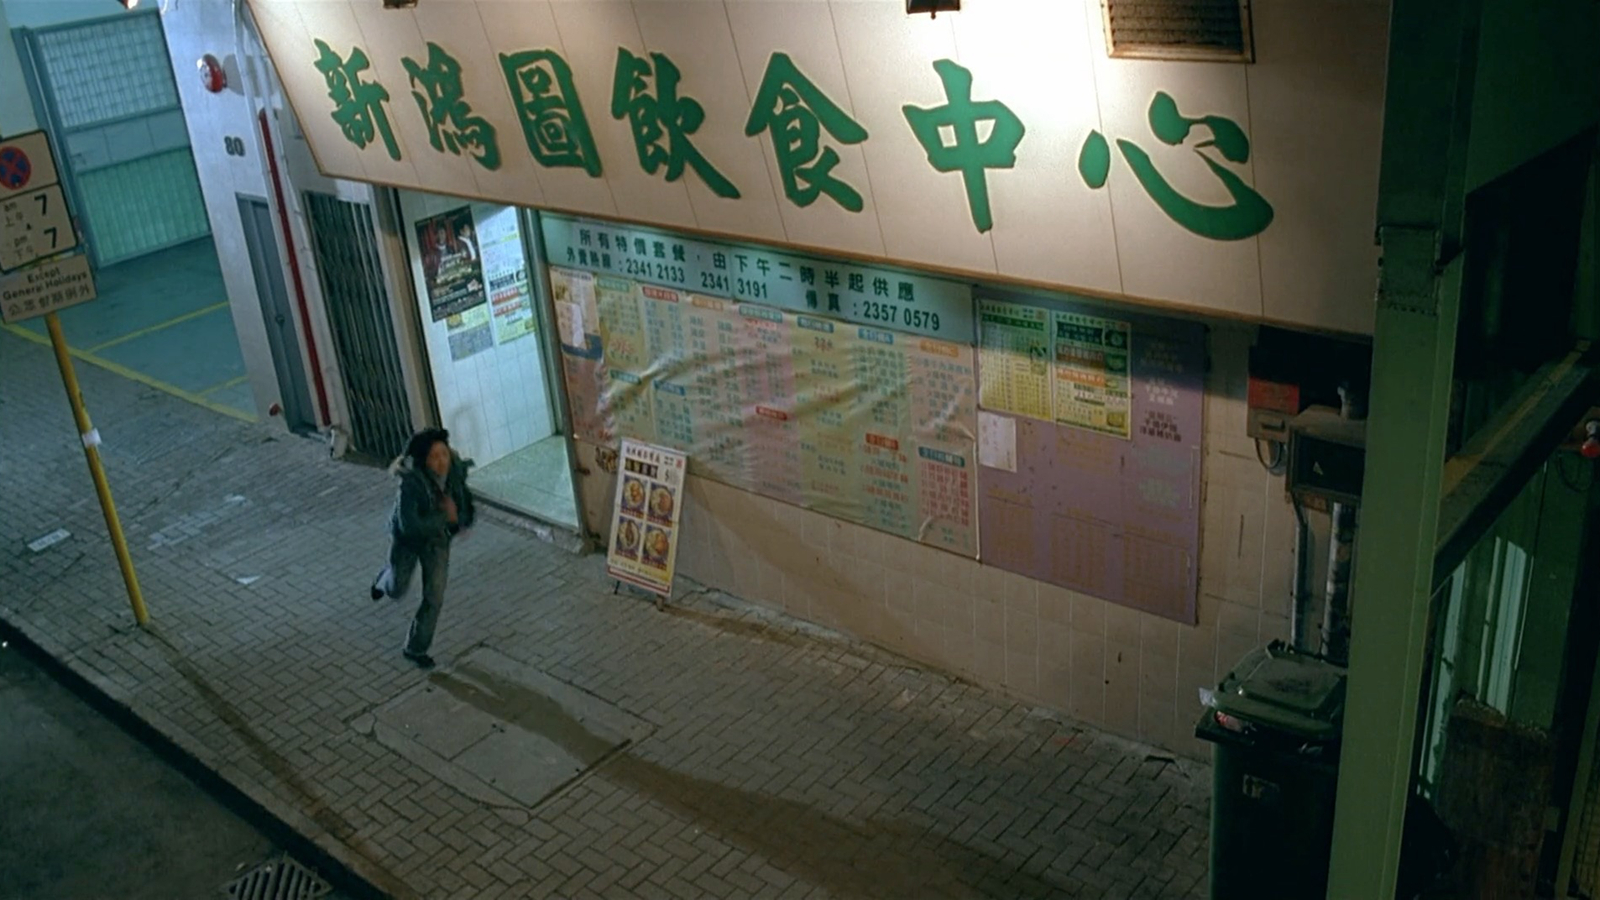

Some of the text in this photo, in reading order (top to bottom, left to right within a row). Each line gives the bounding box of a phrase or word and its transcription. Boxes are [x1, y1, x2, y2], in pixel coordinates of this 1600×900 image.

[224, 136, 245, 157] 80
[314, 38, 1274, 241] 新鴻圖飲食中心
[34, 193, 47, 216] 7
[43, 227, 57, 249] 7
[3, 271, 87, 301] General Holidays
[27, 266, 60, 284] Except
[626, 258, 652, 277] 2341
[656, 263, 686, 283] 2133
[701, 271, 730, 293] 2341
[738, 278, 768, 299] 3191
[863, 303, 897, 323] 2357
[904, 310, 941, 331] 0579
